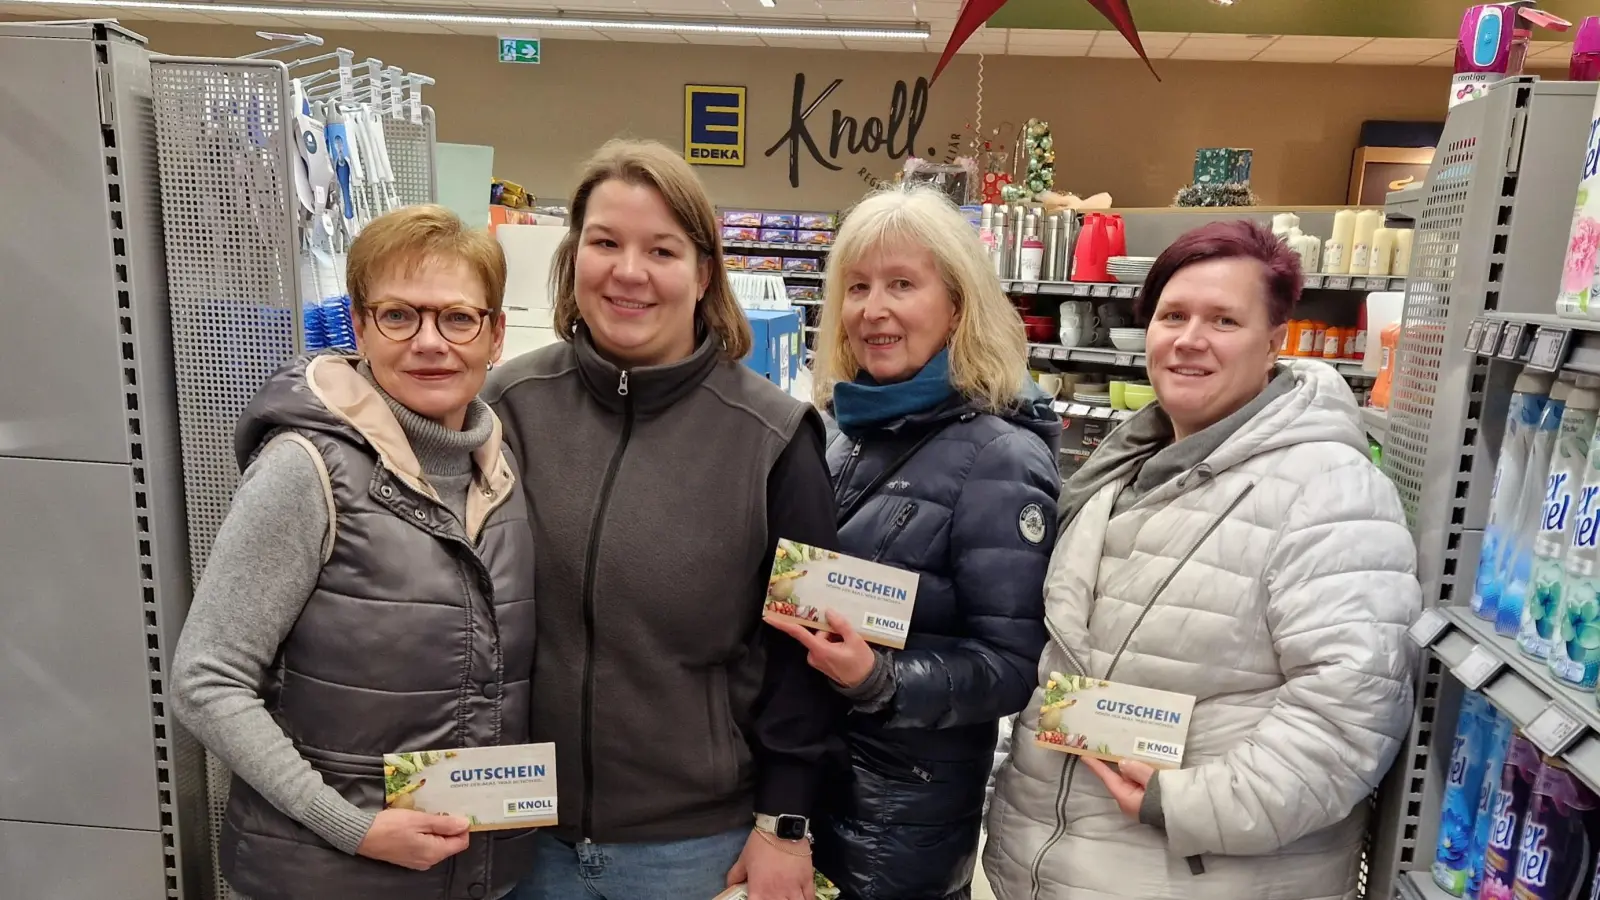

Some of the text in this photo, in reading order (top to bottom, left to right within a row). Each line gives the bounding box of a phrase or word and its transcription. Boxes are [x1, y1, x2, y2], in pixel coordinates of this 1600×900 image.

[690, 148, 740, 160] EDEKA
[828, 571, 907, 601] GUTSCHEIN
[875, 617, 905, 631] KNOLL
[1096, 699, 1181, 724] GUTSCHEIN
[1147, 742, 1179, 755] KNOLL
[450, 764, 545, 782] GUTSCHEIN
[518, 800, 553, 810] KNOLL
